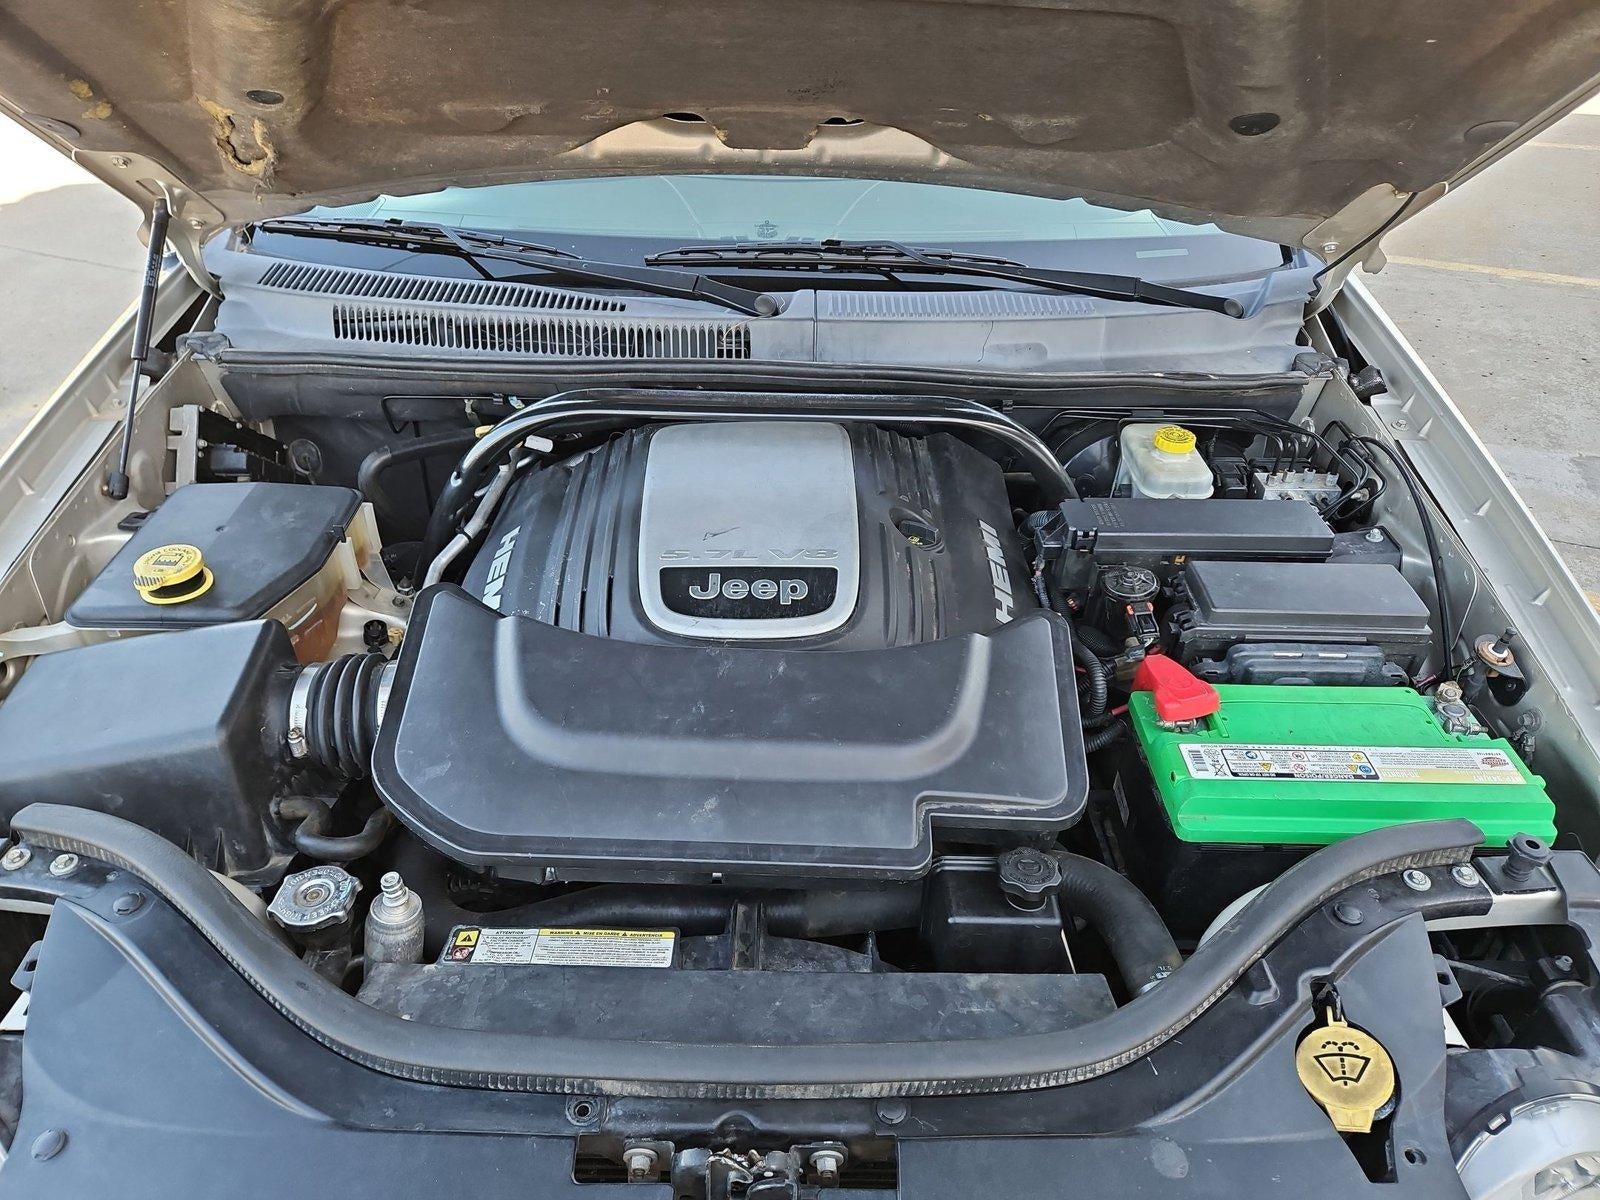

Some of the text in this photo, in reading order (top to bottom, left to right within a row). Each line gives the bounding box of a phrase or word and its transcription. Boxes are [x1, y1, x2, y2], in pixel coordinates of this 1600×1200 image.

[482, 525, 521, 611] HEM
[659, 549, 838, 561] 5.7L V8
[979, 519, 1014, 624] HEMI
[689, 573, 809, 605] Jeep
